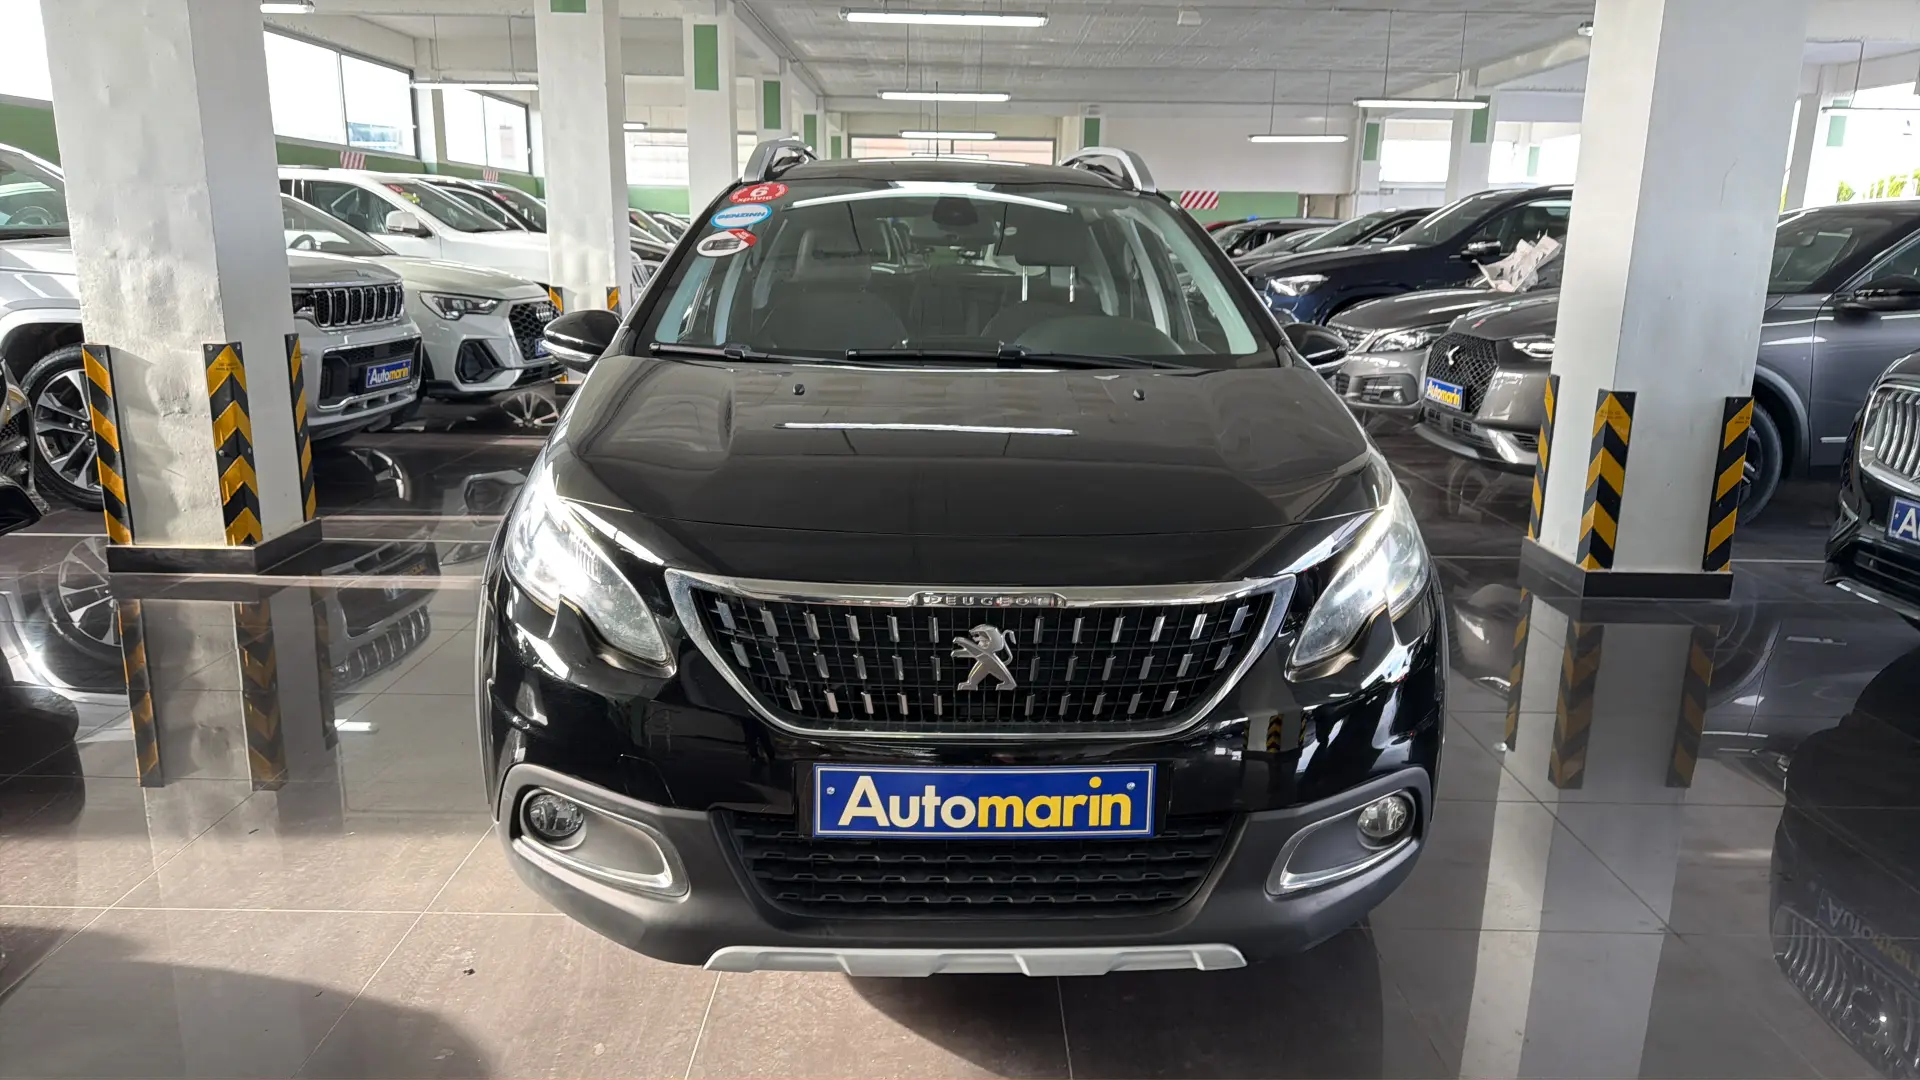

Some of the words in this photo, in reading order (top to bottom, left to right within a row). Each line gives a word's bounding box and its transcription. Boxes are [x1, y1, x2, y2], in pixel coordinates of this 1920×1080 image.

[750, 186, 769, 197] 6
[923, 596, 1048, 606] PEUGEOT
[838, 775, 1131, 828] Automarin
